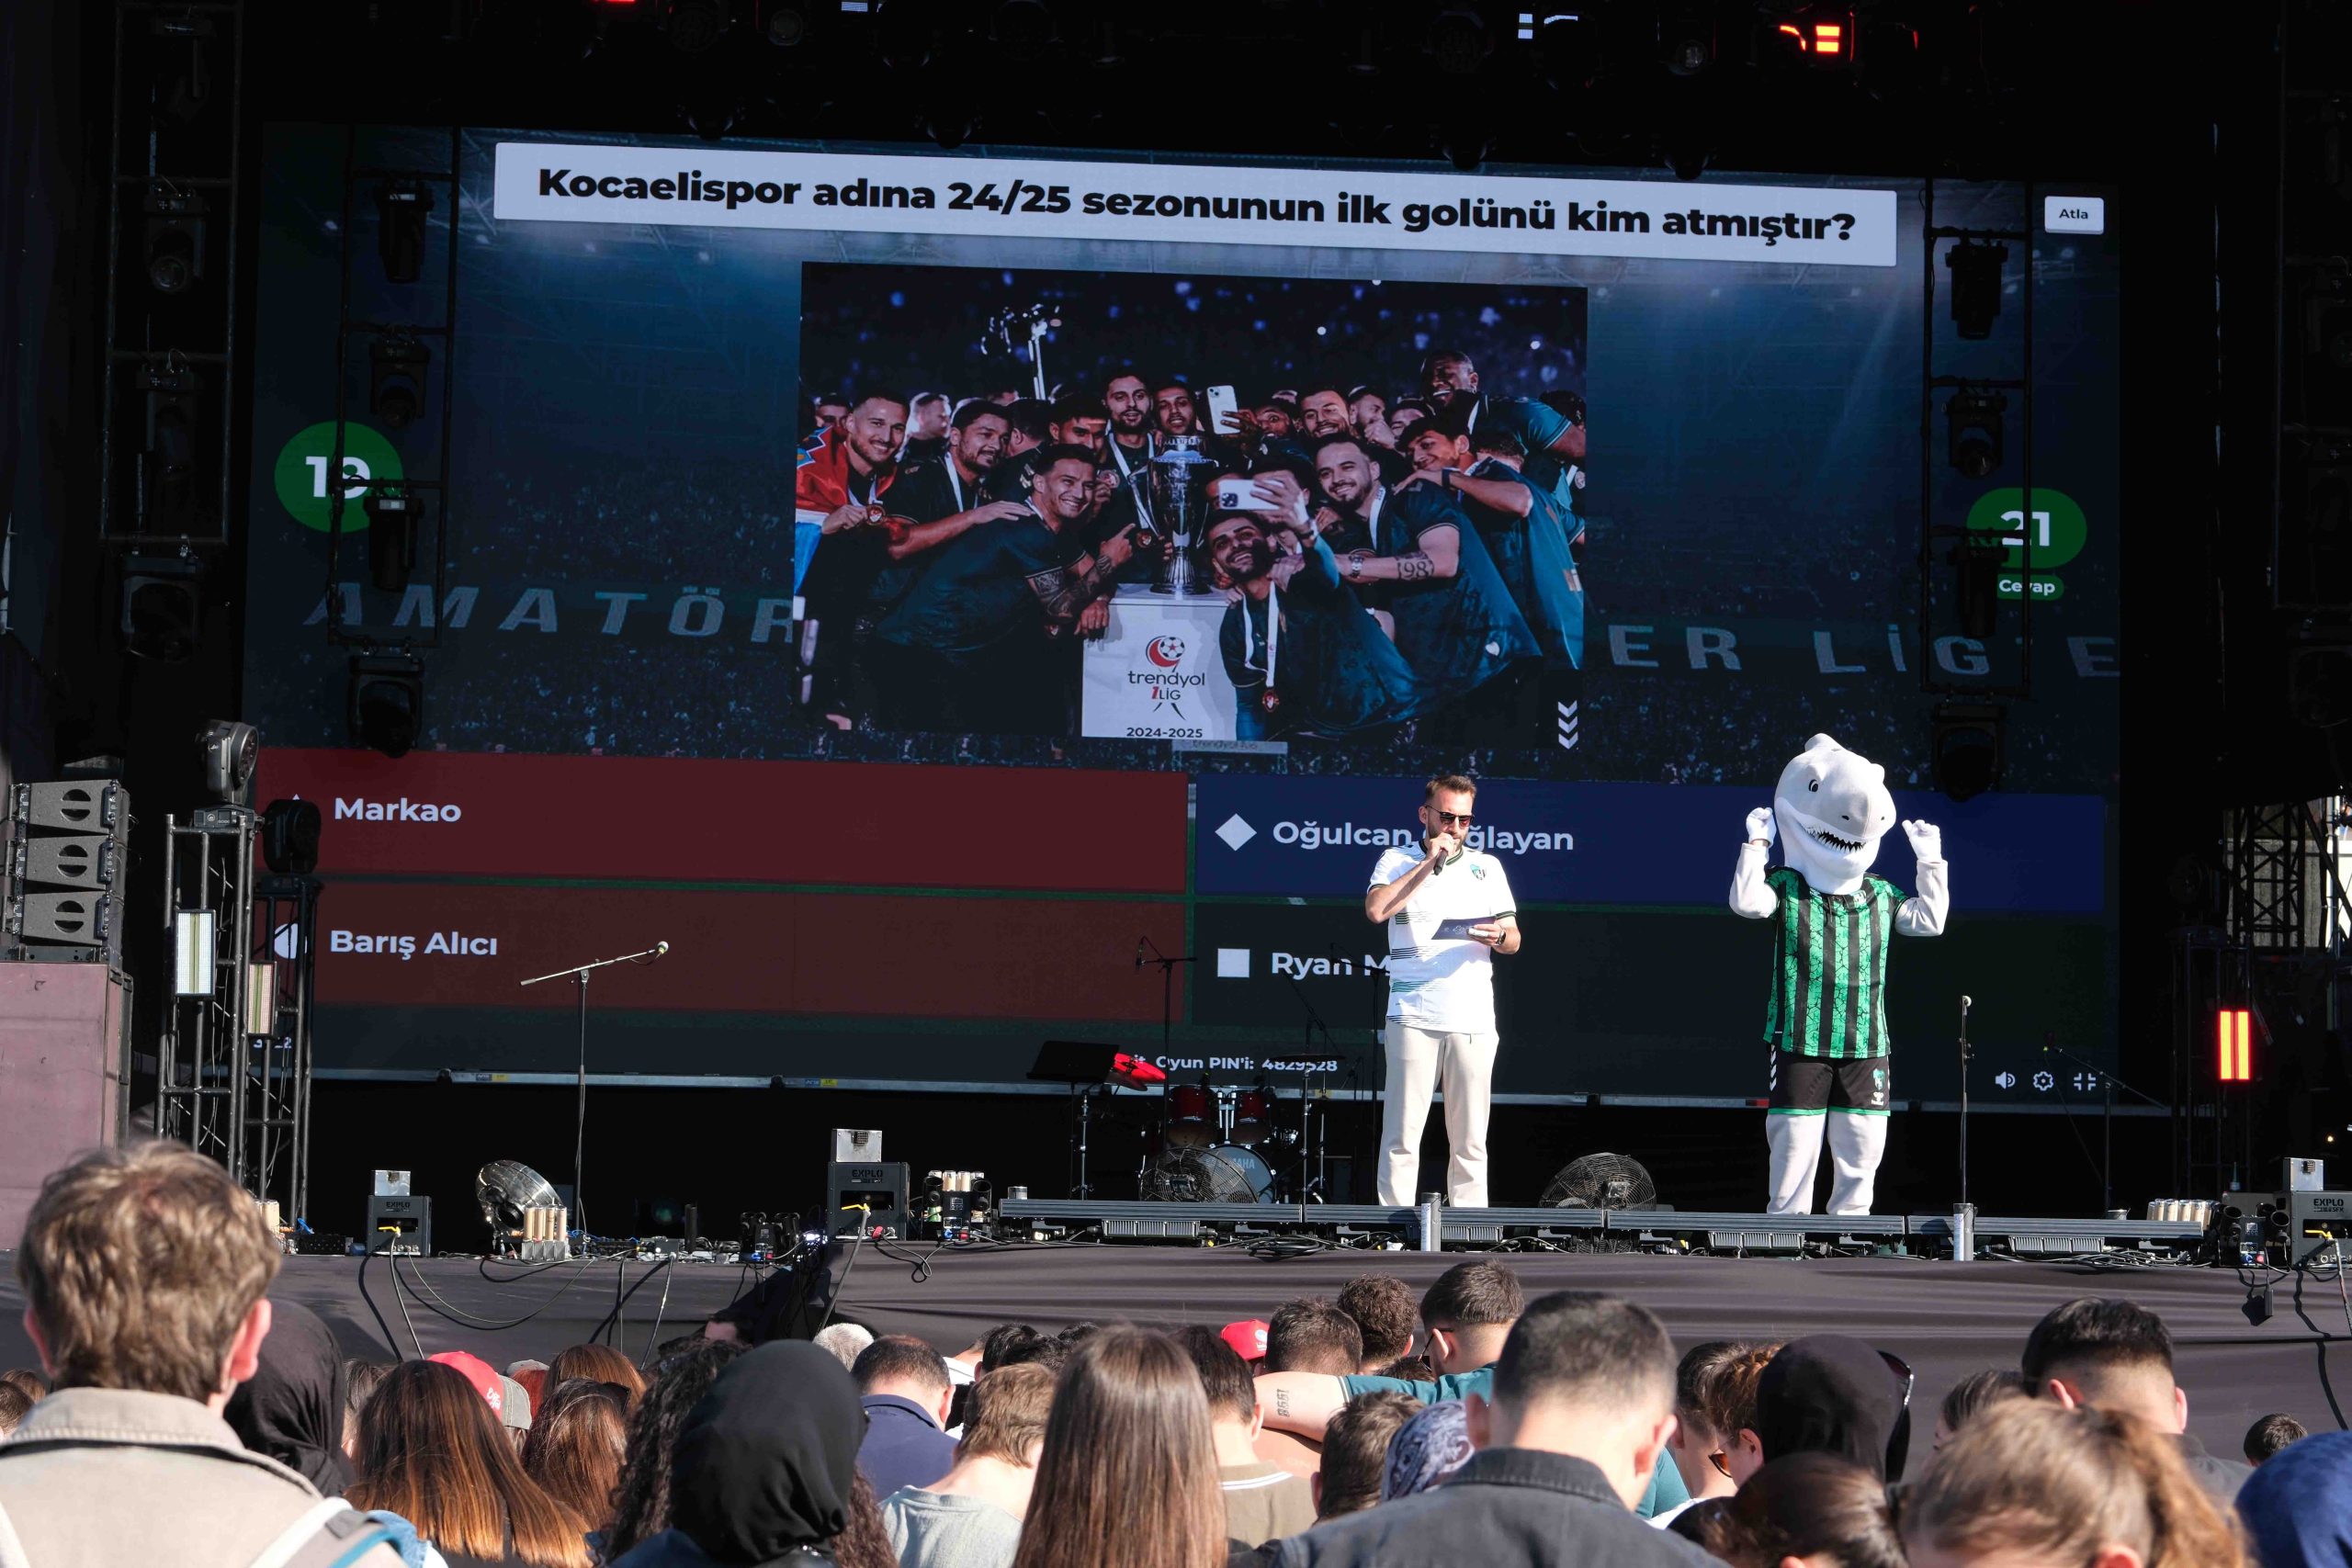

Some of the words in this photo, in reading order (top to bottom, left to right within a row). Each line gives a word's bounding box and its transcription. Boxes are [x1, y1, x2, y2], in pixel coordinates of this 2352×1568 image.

[539, 168, 802, 210] Kocaelispor
[812, 177, 935, 209] adına
[947, 179, 1071, 216] 24/25
[1082, 192, 1325, 223] sezonunun
[1338, 191, 1392, 225] ilk
[1402, 197, 1555, 232] golünü
[1568, 200, 1650, 233] kim
[1662, 209, 1857, 247] atmıştır?
[2059, 209, 2088, 220] Atla
[2000, 510, 2051, 547] 21
[1998, 579, 2056, 596] Ceap
[302, 581, 795, 644] AMATÖR
[1127, 671, 1205, 688] trendyol
[1125, 727, 1204, 739] 2024-2025
[334, 797, 462, 822] Markao
[1272, 820, 1411, 851] Oğulcan
[1423, 825, 1574, 855] ğlayan
[330, 930, 416, 961] Barış
[424, 931, 497, 955] Alıcı
[1272, 952, 1352, 981] Ryan
[1156, 1055, 1204, 1071] Oyun
[1209, 1056, 1254, 1070] PIN'i:
[853, 1168, 883, 1178] EXPLO
[2313, 1198, 2344, 1207] EXPLO
